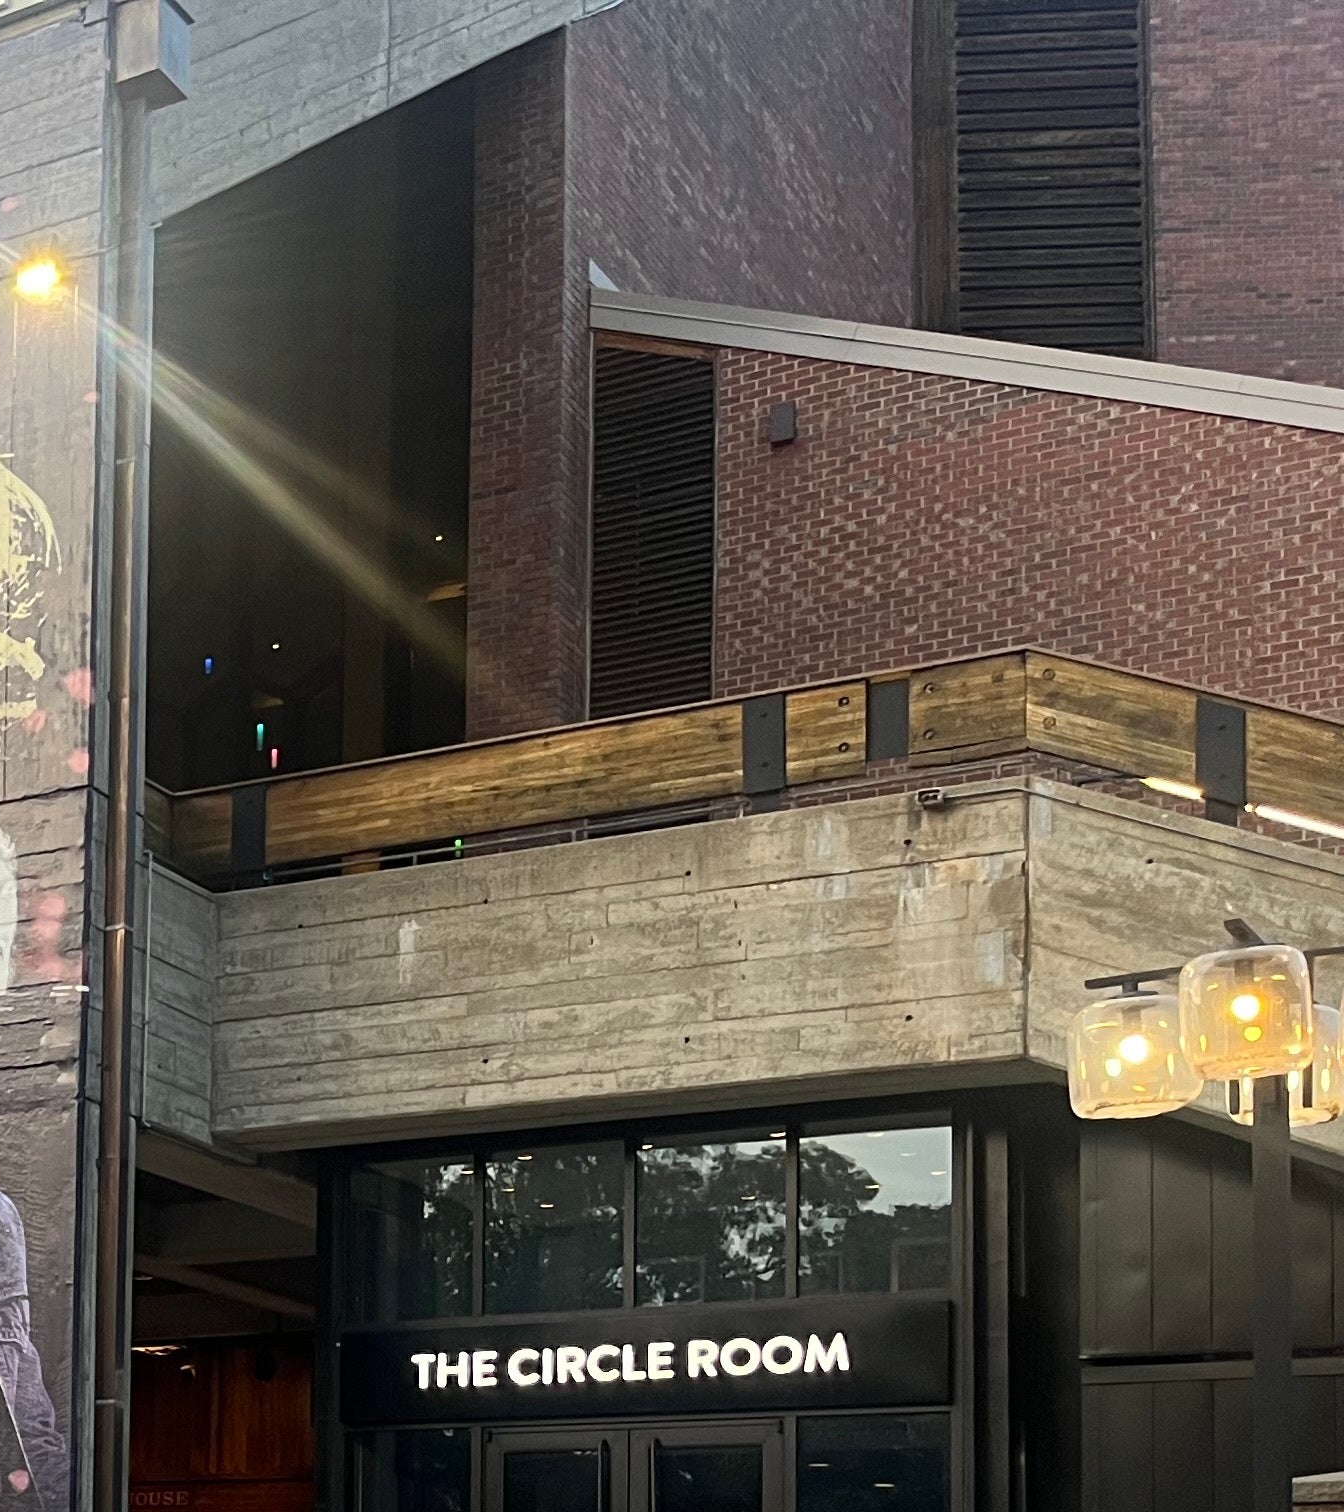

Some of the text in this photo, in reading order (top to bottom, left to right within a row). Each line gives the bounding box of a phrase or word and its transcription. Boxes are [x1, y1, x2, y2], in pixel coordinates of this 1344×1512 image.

[411, 1332, 850, 1389] THE CIRCLE ROOM
